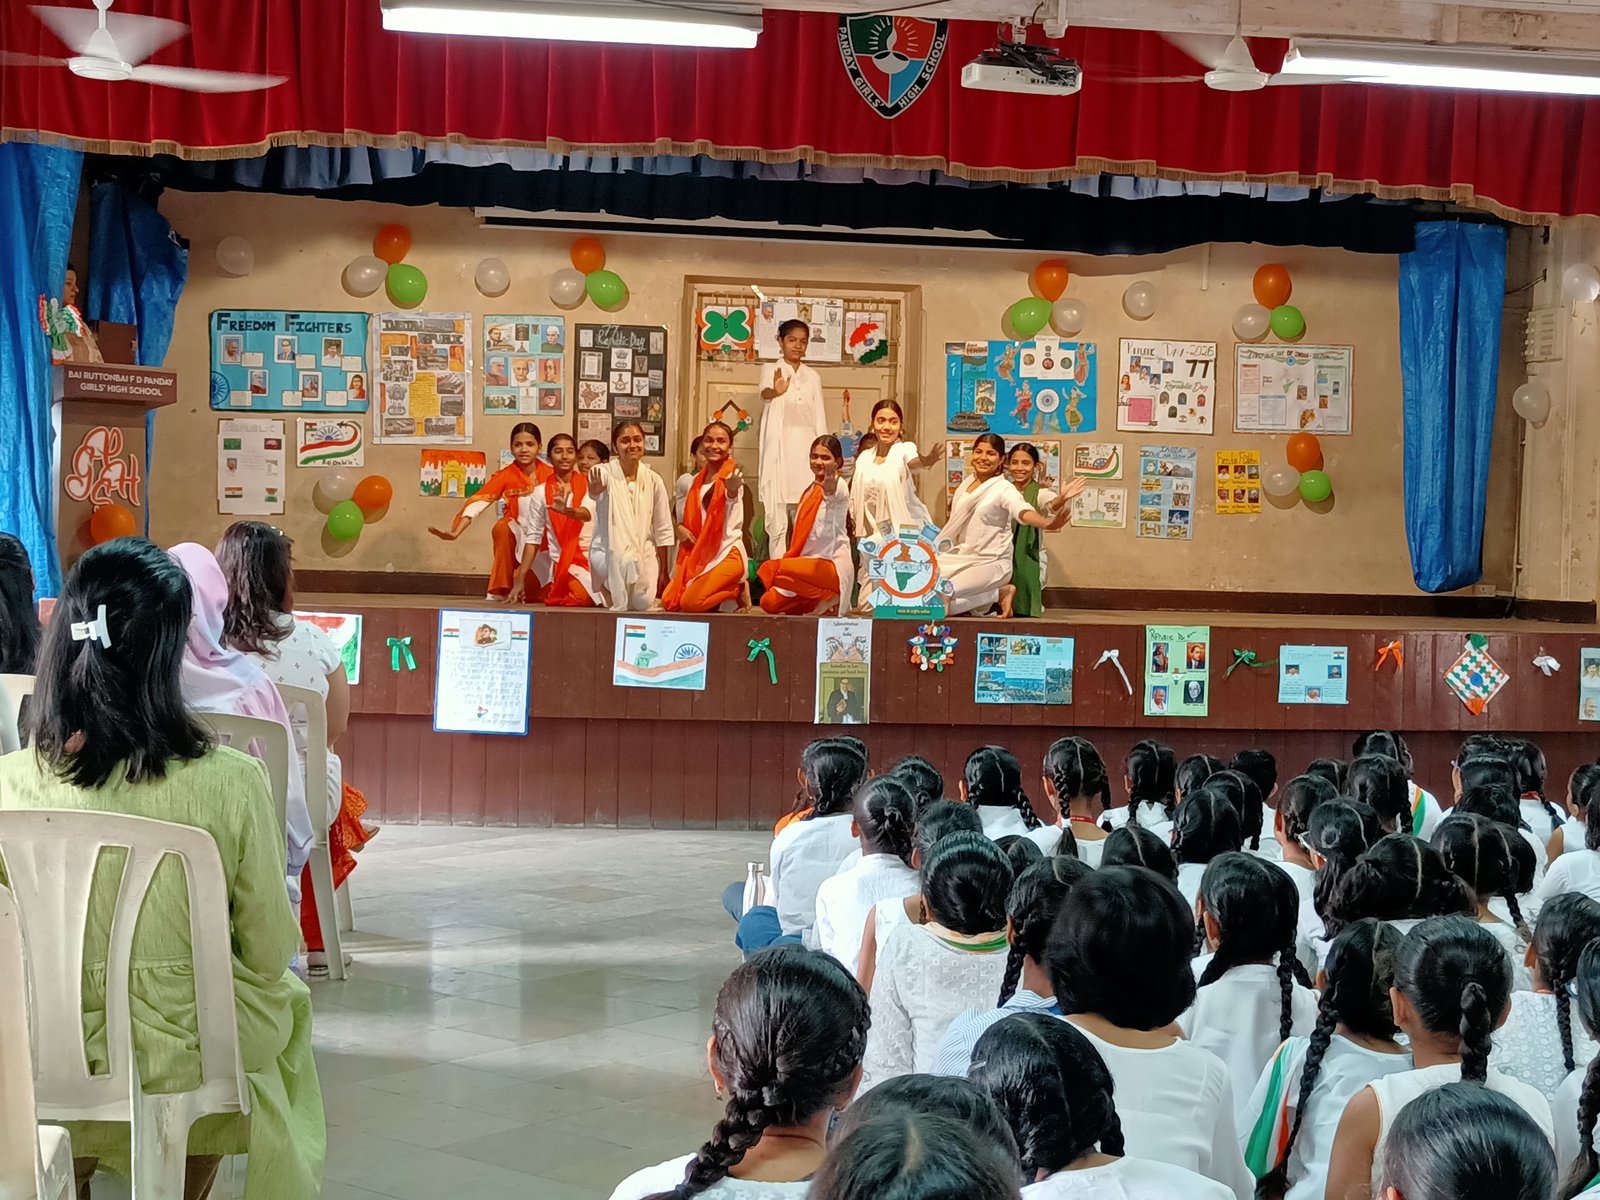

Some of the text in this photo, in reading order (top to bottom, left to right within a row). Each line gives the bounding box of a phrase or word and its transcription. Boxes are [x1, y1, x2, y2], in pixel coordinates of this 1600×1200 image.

[838, 27, 946, 109] PANDAY GIRLS' HIGH SCHOOL
[68, 370, 83, 379] BAI
[83, 371, 129, 383] RUTTONBAI
[129, 375, 136, 383] F
[143, 377, 174, 386] PANDAY
[1185, 359, 1213, 379] 77
[80, 382, 163, 397] GIRLS' HIGH SCHOOL
